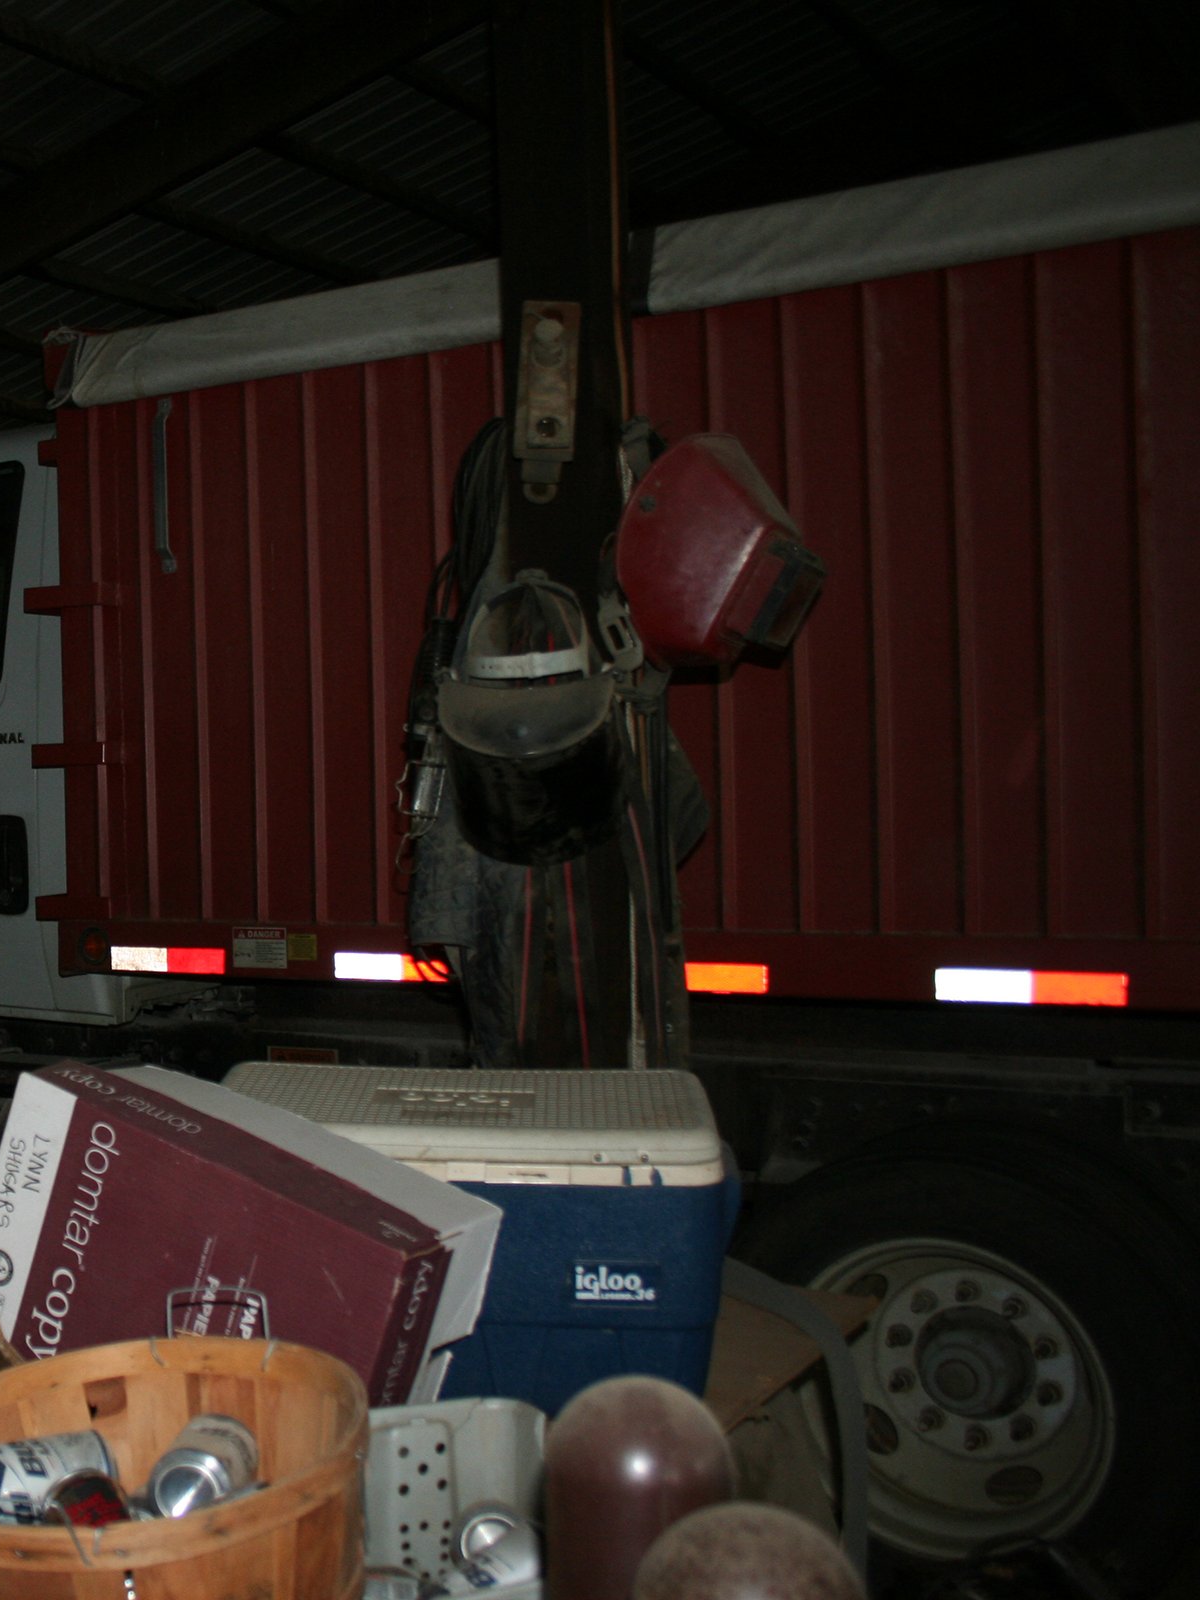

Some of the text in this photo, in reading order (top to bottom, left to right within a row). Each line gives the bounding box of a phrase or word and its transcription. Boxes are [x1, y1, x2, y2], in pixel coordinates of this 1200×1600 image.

[246, 930, 281, 938] DANGER
[53, 1069, 203, 1135] domtar copy
[21, 1133, 51, 1194] LYNN
[25, 1120, 121, 1361] domtar copy
[402, 1258, 435, 1331] copy
[575, 1265, 642, 1300] igloo
